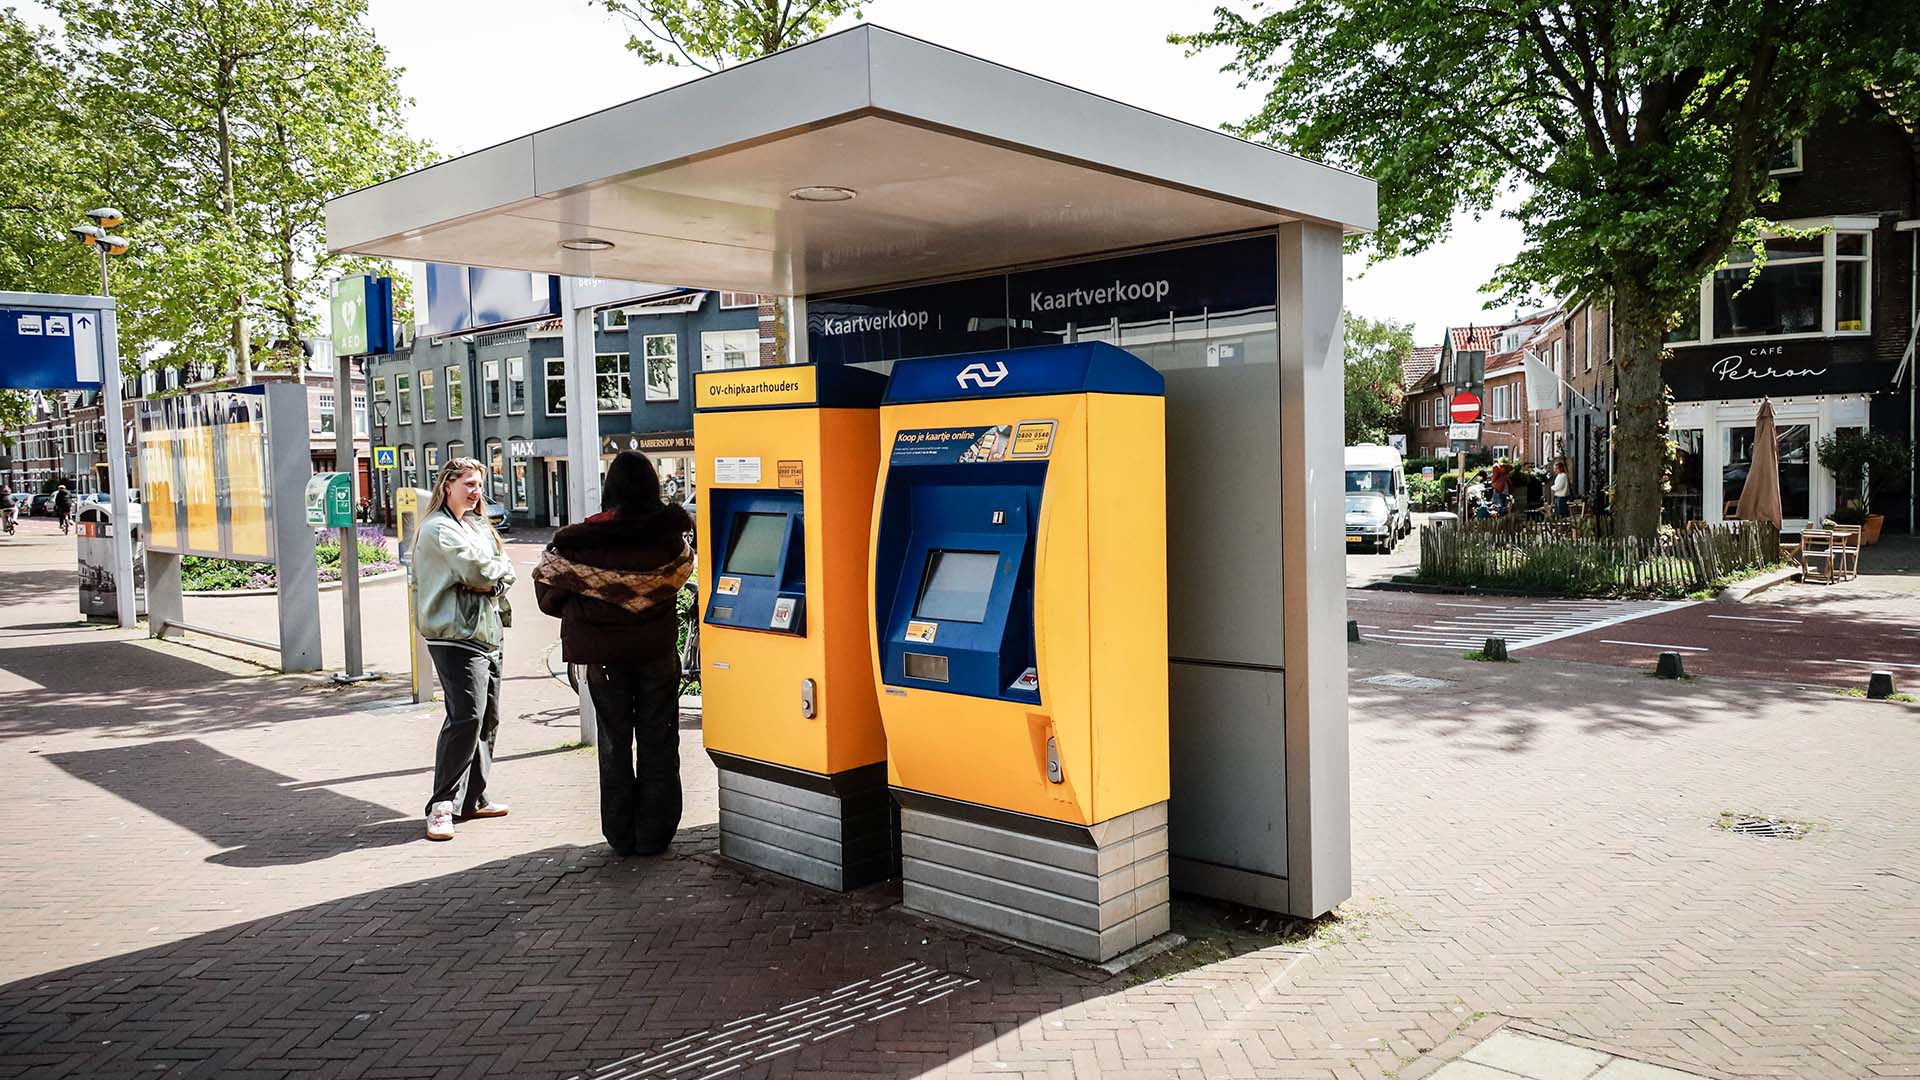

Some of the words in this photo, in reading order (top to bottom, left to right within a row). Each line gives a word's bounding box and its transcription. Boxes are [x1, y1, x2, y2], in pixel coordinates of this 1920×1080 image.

[1030, 278, 1170, 312] Kaartverkoop
[823, 309, 929, 337] Kaartverkoop
[342, 335, 360, 348] AED
[1750, 345, 1783, 356] CAFÉ
[1712, 355, 1827, 381] Perron
[709, 380, 799, 397] OV-chipkaarthouders
[640, 438, 675, 448] BARBERSHOP
[898, 433, 916, 443] Koop
[916, 433, 925, 443] je
[925, 432, 950, 443] kaartje
[951, 431, 975, 440] online
[511, 441, 534, 456] MAX
